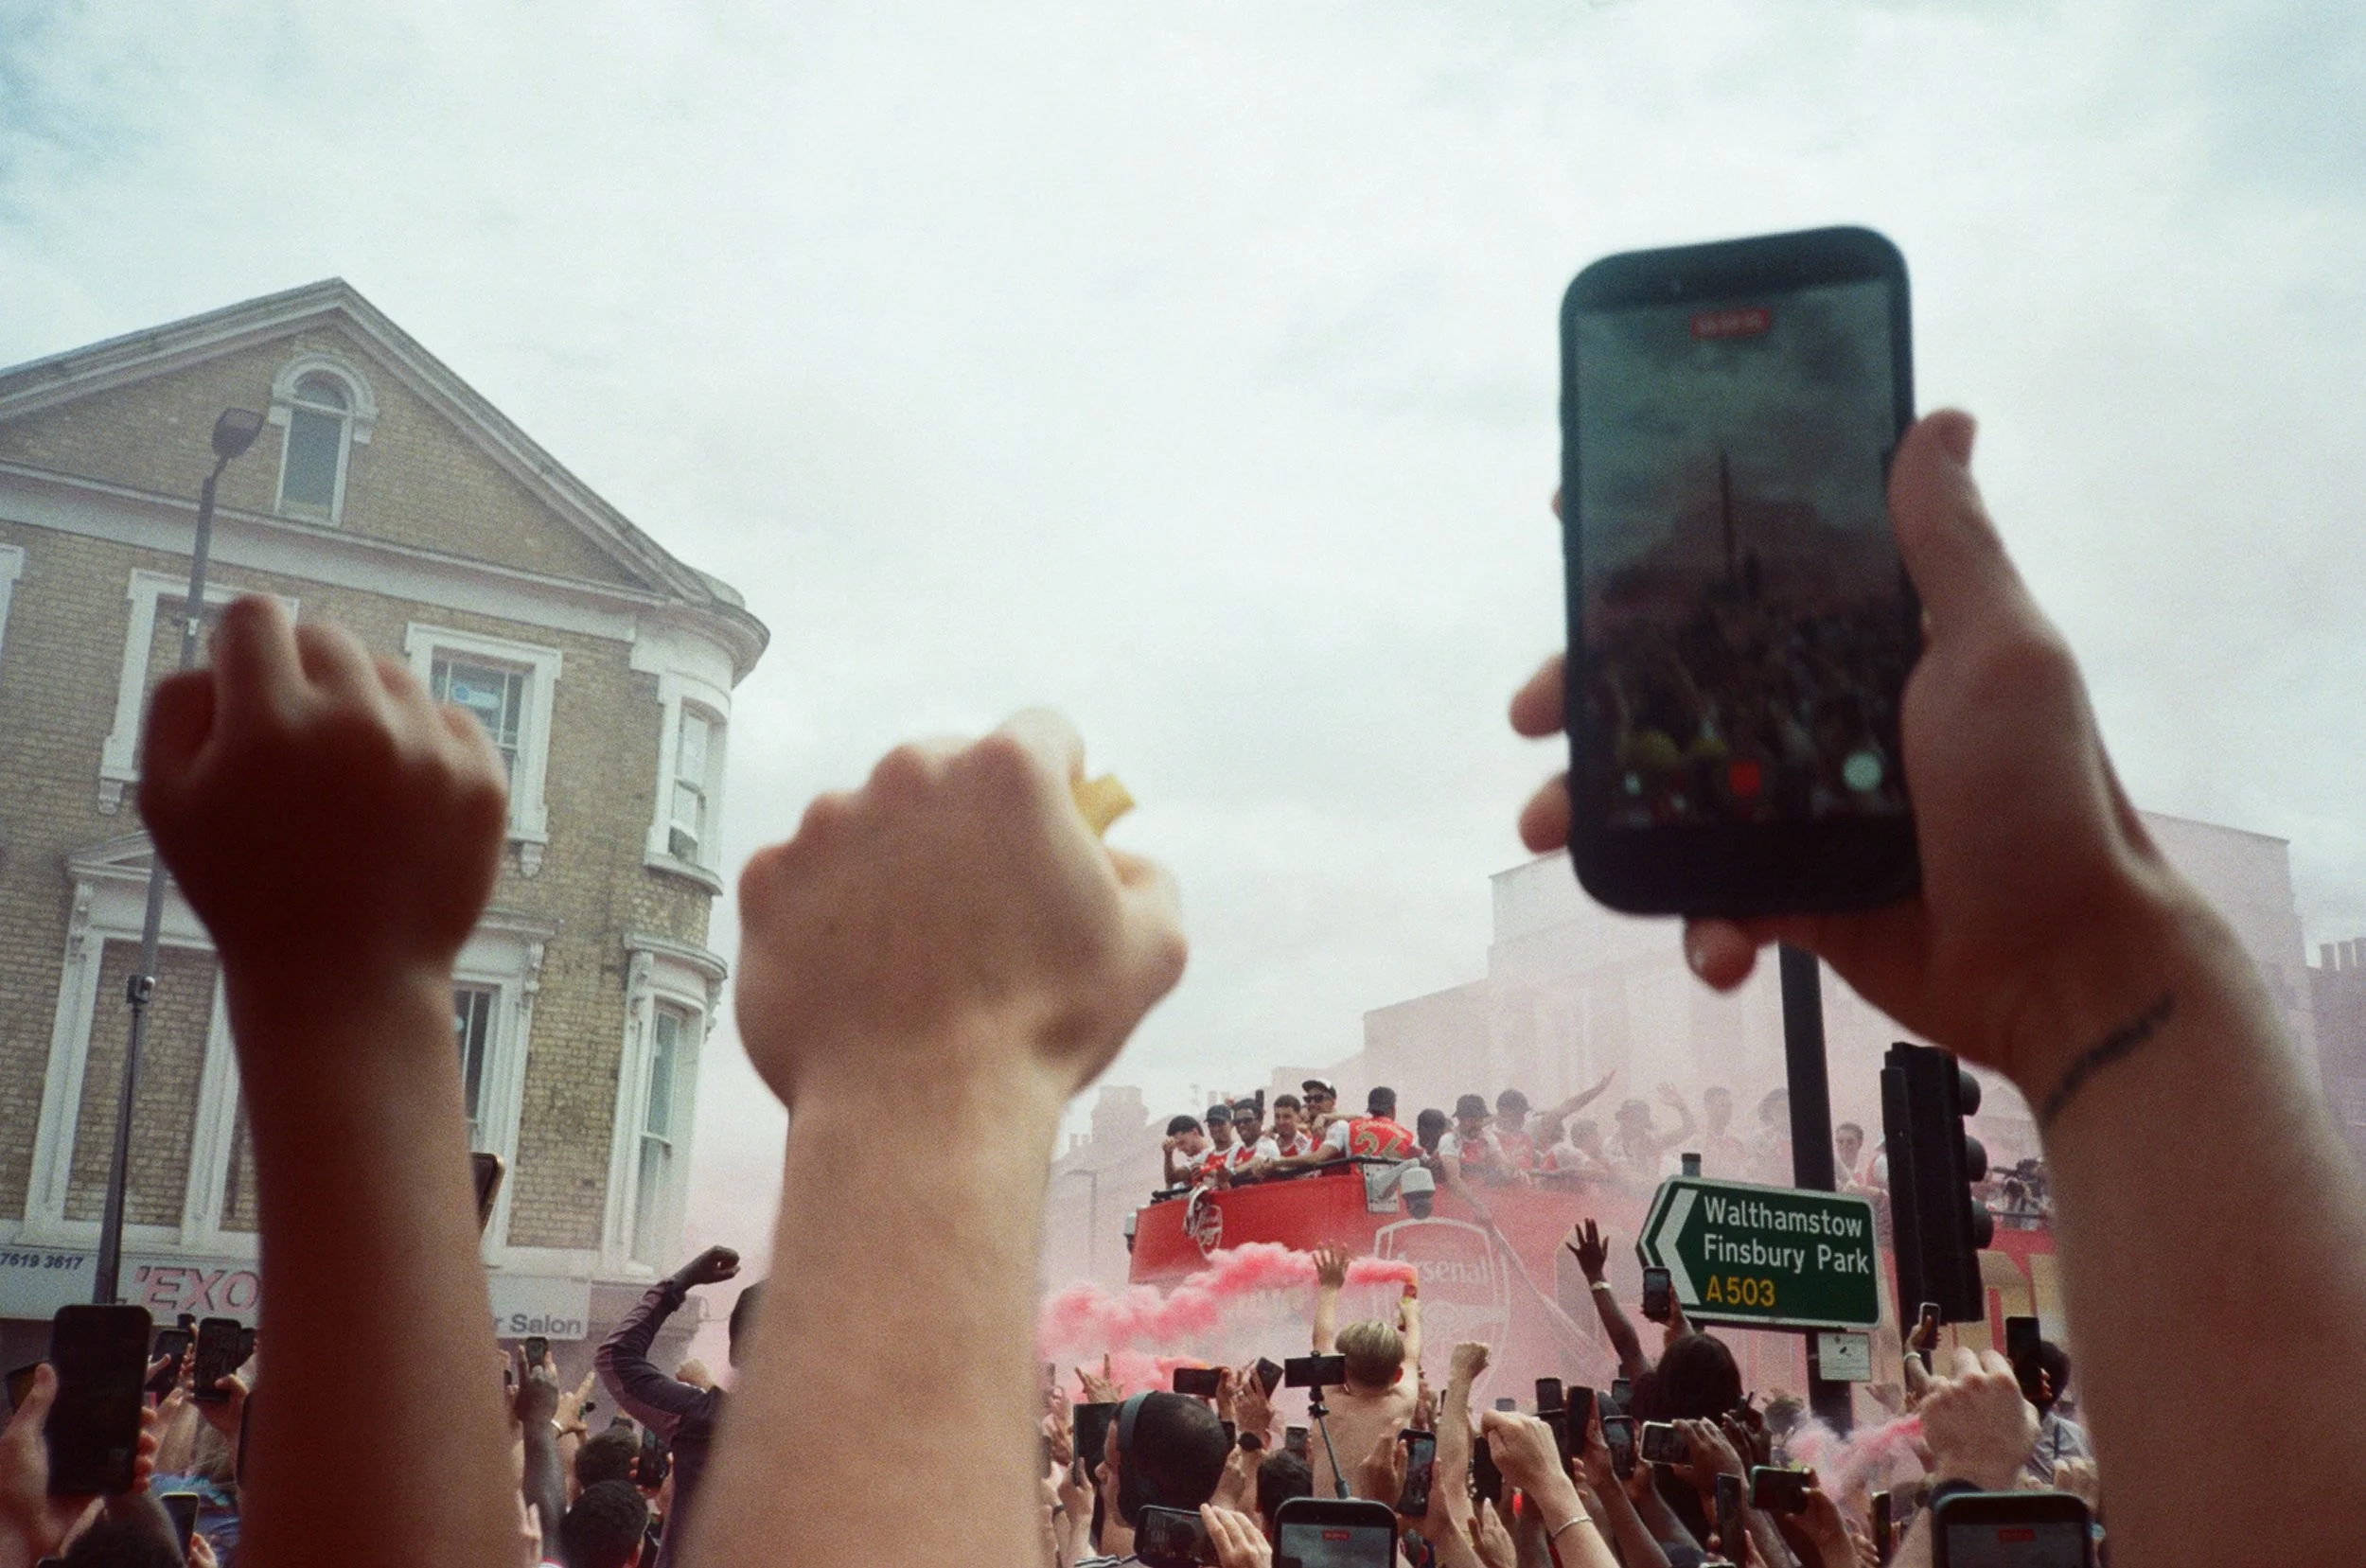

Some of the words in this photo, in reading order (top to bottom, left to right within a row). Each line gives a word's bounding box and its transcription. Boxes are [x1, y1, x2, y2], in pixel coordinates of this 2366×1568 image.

[1704, 1196, 1863, 1238] Walthamstow
[44, 1254, 84, 1271] 3617
[1704, 1233, 1806, 1274] Finsbury
[1817, 1243, 1870, 1275] Park
[1706, 1275, 1775, 1308] A503
[510, 1313, 581, 1334] Salon
